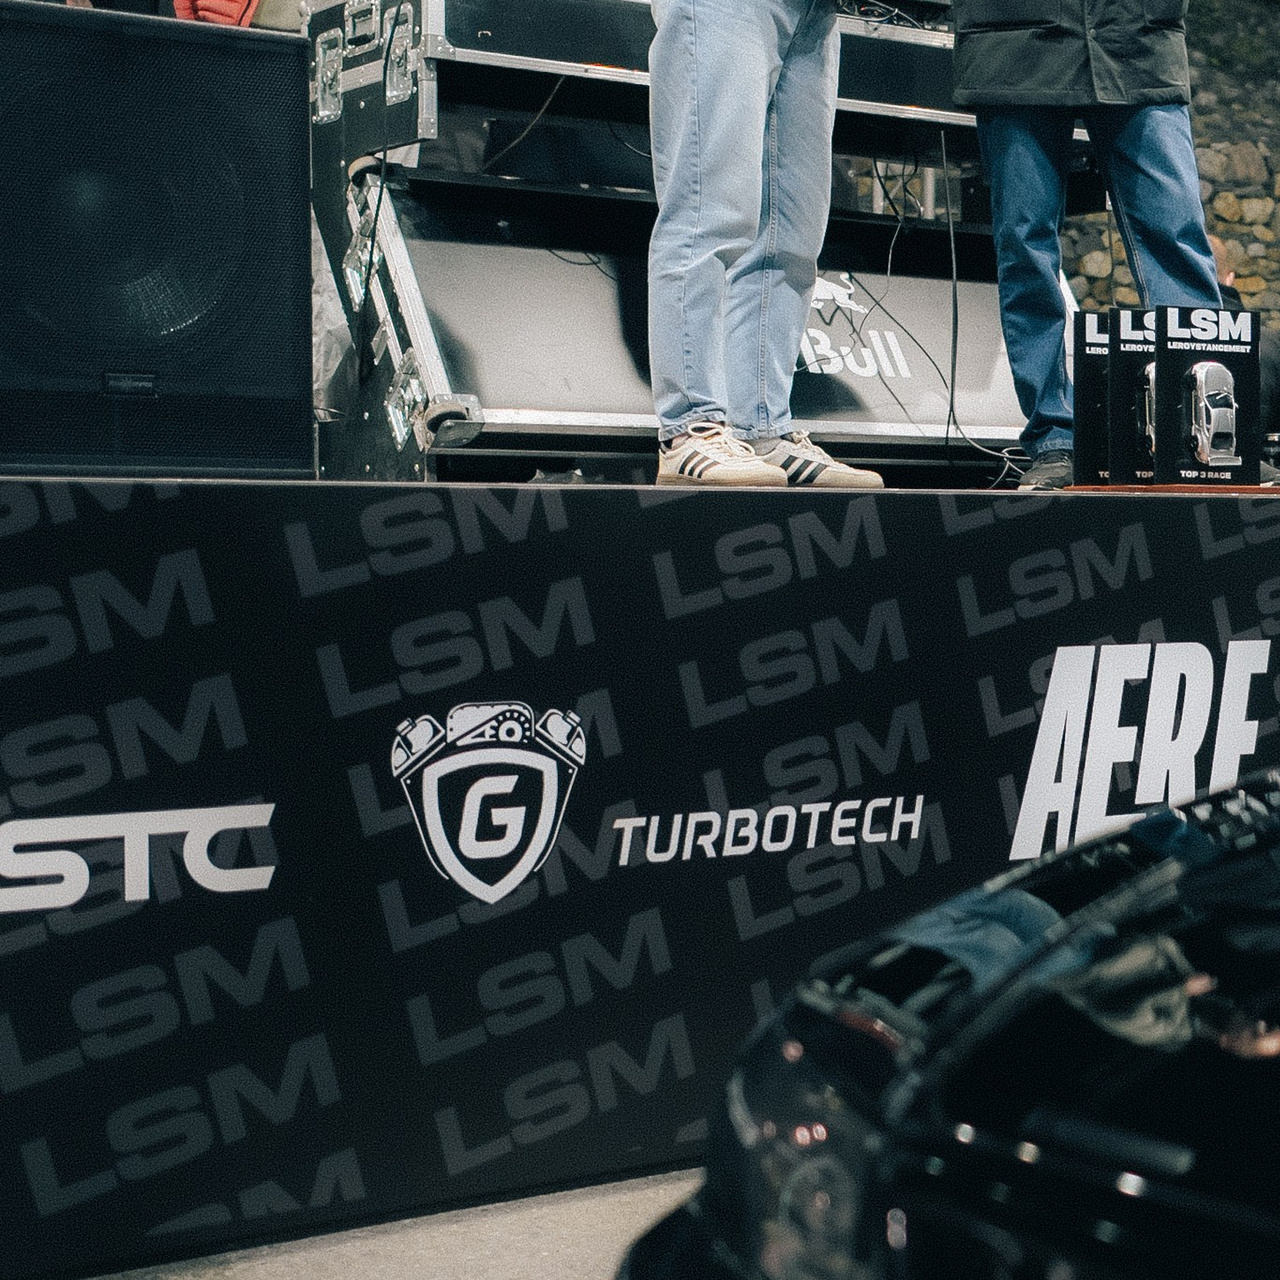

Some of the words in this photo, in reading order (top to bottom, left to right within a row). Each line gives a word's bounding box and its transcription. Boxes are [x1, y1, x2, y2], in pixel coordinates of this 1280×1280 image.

[799, 327, 912, 379] Bull
[1166, 306, 1252, 342] LSM
[1166, 341, 1252, 353] LEROYSTANCEMEET
[1180, 470, 1199, 479] TOP
[1200, 471, 1206, 479] 3
[1207, 471, 1232, 480] RACE
[284, 490, 569, 598] LSM
[652, 495, 887, 620] LSM
[956, 522, 1154, 638] LSM
[315, 575, 596, 720] LSM
[678, 597, 910, 729] LSM
[0, 673, 249, 819] SM
[455, 773, 528, 861] G
[612, 794, 925, 867] TURBOTECH
[0, 916, 312, 1095] LSM
[406, 906, 673, 1067] LSM
[19, 1032, 342, 1218] LSM
[434, 1012, 696, 1177] LSM
